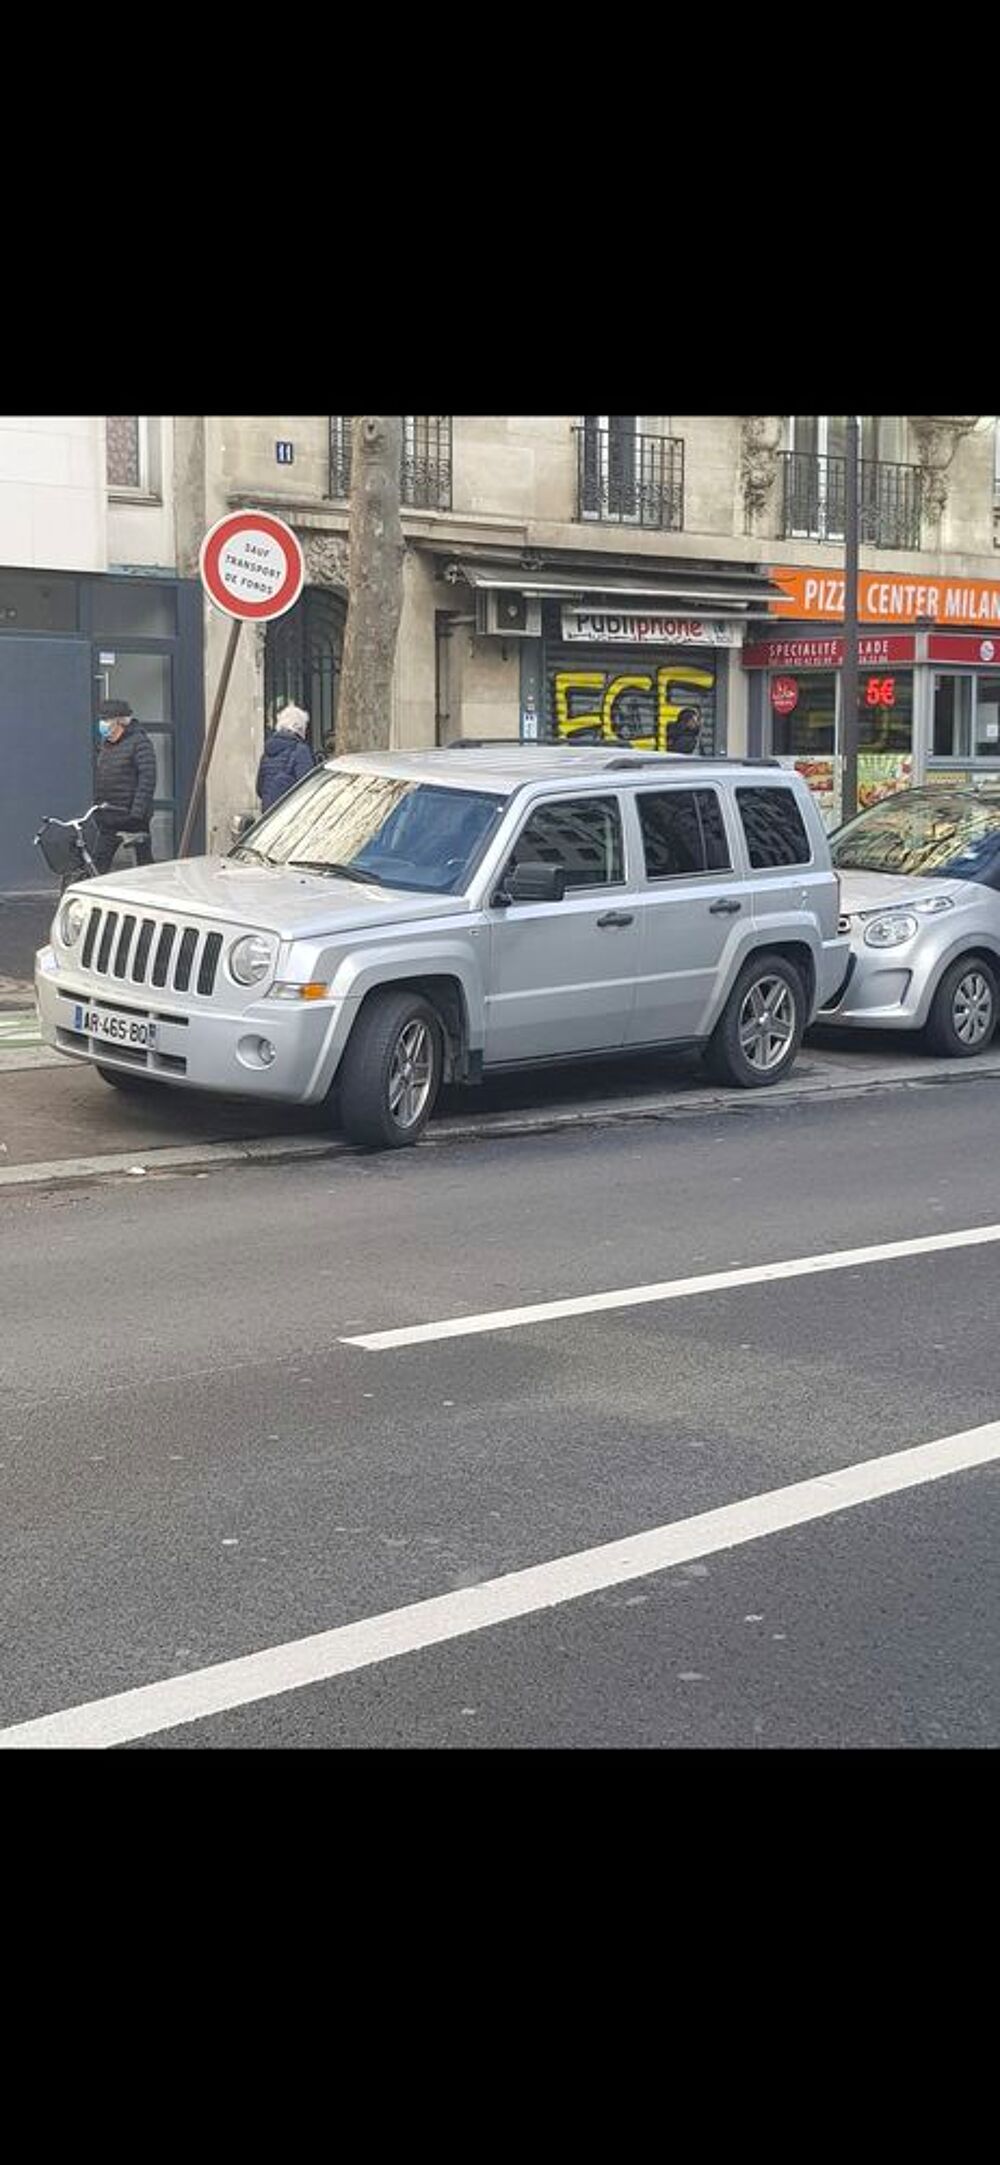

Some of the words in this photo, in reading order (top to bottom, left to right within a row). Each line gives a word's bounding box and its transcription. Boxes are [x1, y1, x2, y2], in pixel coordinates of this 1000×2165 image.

[279, 443, 292, 462] 11
[245, 543, 270, 557] SAUF
[225, 554, 281, 578] TRANSPORT
[224, 573, 237, 584] DE
[241, 577, 273, 595] FONDS
[804, 579, 858, 612] PIZZ
[867, 584, 938, 616] CENTER
[866, 676, 896, 705] 5€
